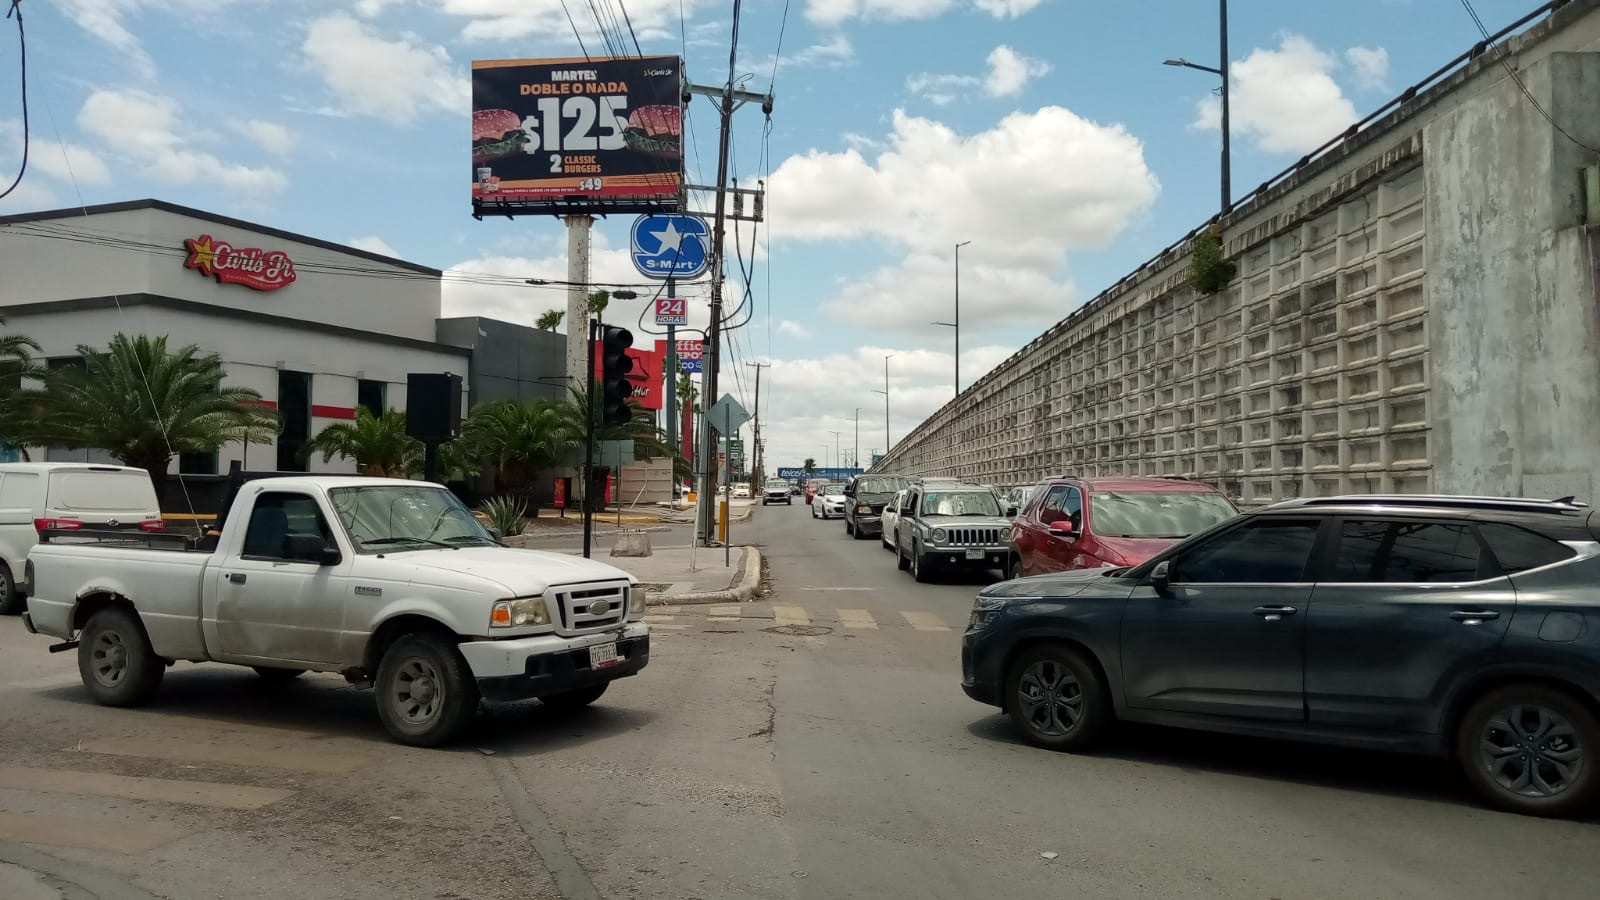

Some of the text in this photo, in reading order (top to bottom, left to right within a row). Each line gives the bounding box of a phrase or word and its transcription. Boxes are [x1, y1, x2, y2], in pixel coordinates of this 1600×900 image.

[551, 70, 597, 81] MARTES
[520, 81, 628, 95] DOBLE O NADA
[520, 95, 628, 154] $125
[549, 153, 562, 173] 2
[564, 155, 596, 164] CLASSIC
[564, 164, 602, 174] BURGERS
[579, 177, 603, 191] $49
[213, 244, 295, 278] Carl's Jr.
[659, 300, 683, 315] 24
